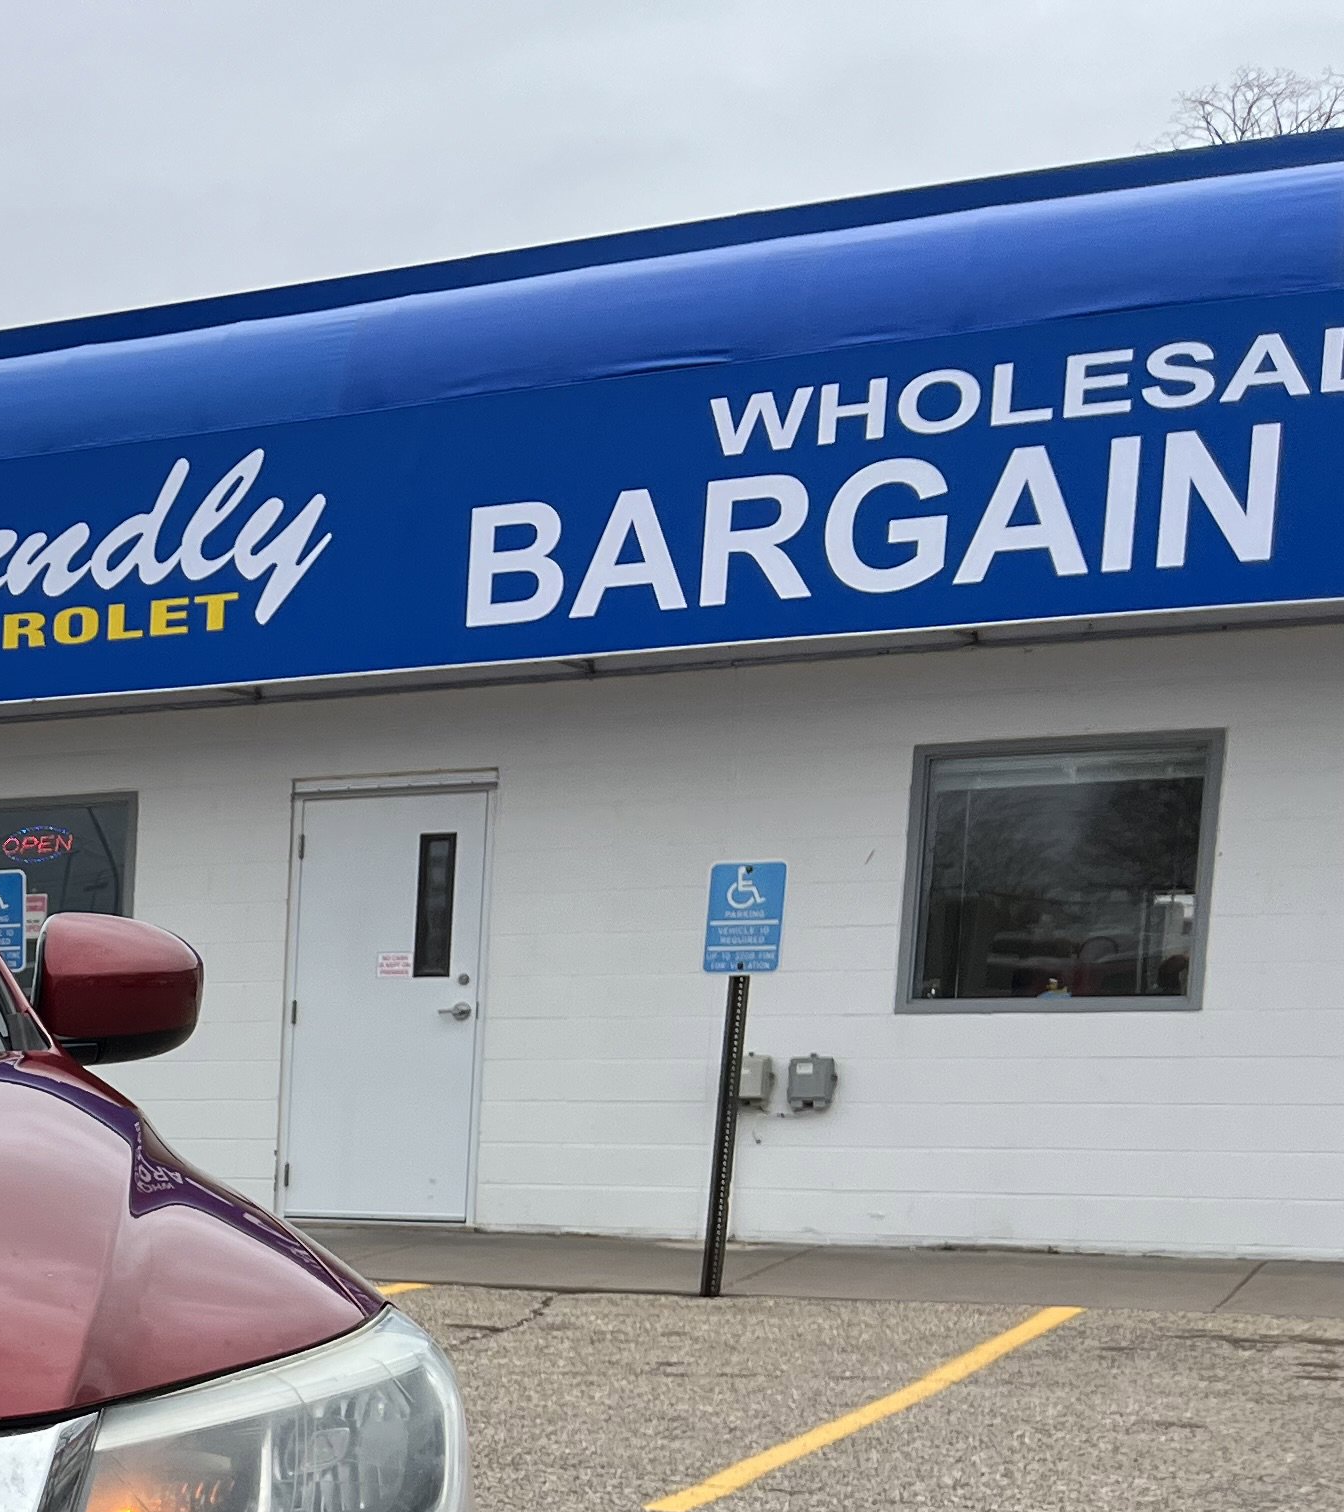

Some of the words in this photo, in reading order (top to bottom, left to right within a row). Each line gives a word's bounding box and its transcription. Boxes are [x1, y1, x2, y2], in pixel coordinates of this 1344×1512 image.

[465, 422, 1283, 628] BARGAIN
[2, 834, 73, 855] OPEN
[724, 909, 765, 918] PARKING
